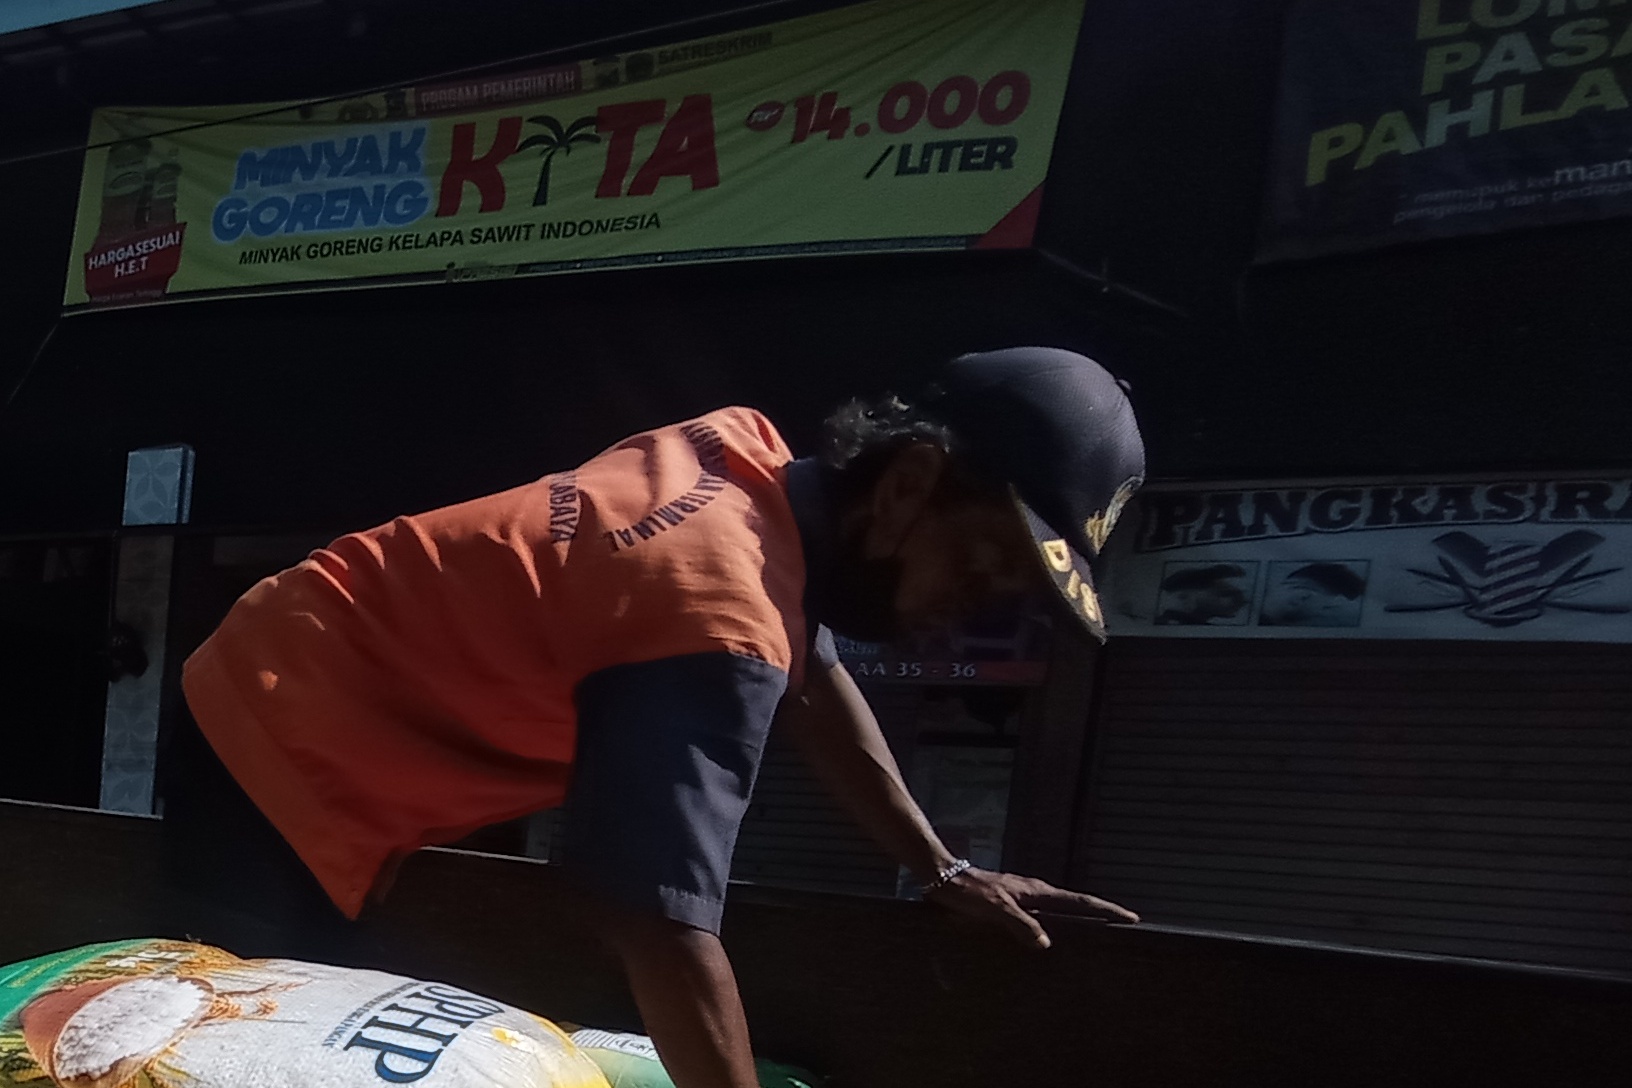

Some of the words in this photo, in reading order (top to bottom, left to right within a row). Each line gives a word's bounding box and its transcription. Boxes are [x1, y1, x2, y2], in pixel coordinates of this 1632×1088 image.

[791, 70, 1031, 144] 14.000
[234, 125, 426, 191] MINYAK
[212, 180, 431, 244] GORENG
[239, 244, 302, 266] MINYAK
[306, 237, 384, 260] GORENG
[388, 229, 465, 252] KELAPA
[469, 223, 535, 245] SAWIT
[540, 212, 661, 240] INDONESIA
[1140, 482, 1535, 552] PANGKAS
[895, 661, 923, 679] 35
[948, 661, 977, 679] 36
[343, 984, 506, 1084] SPHP
